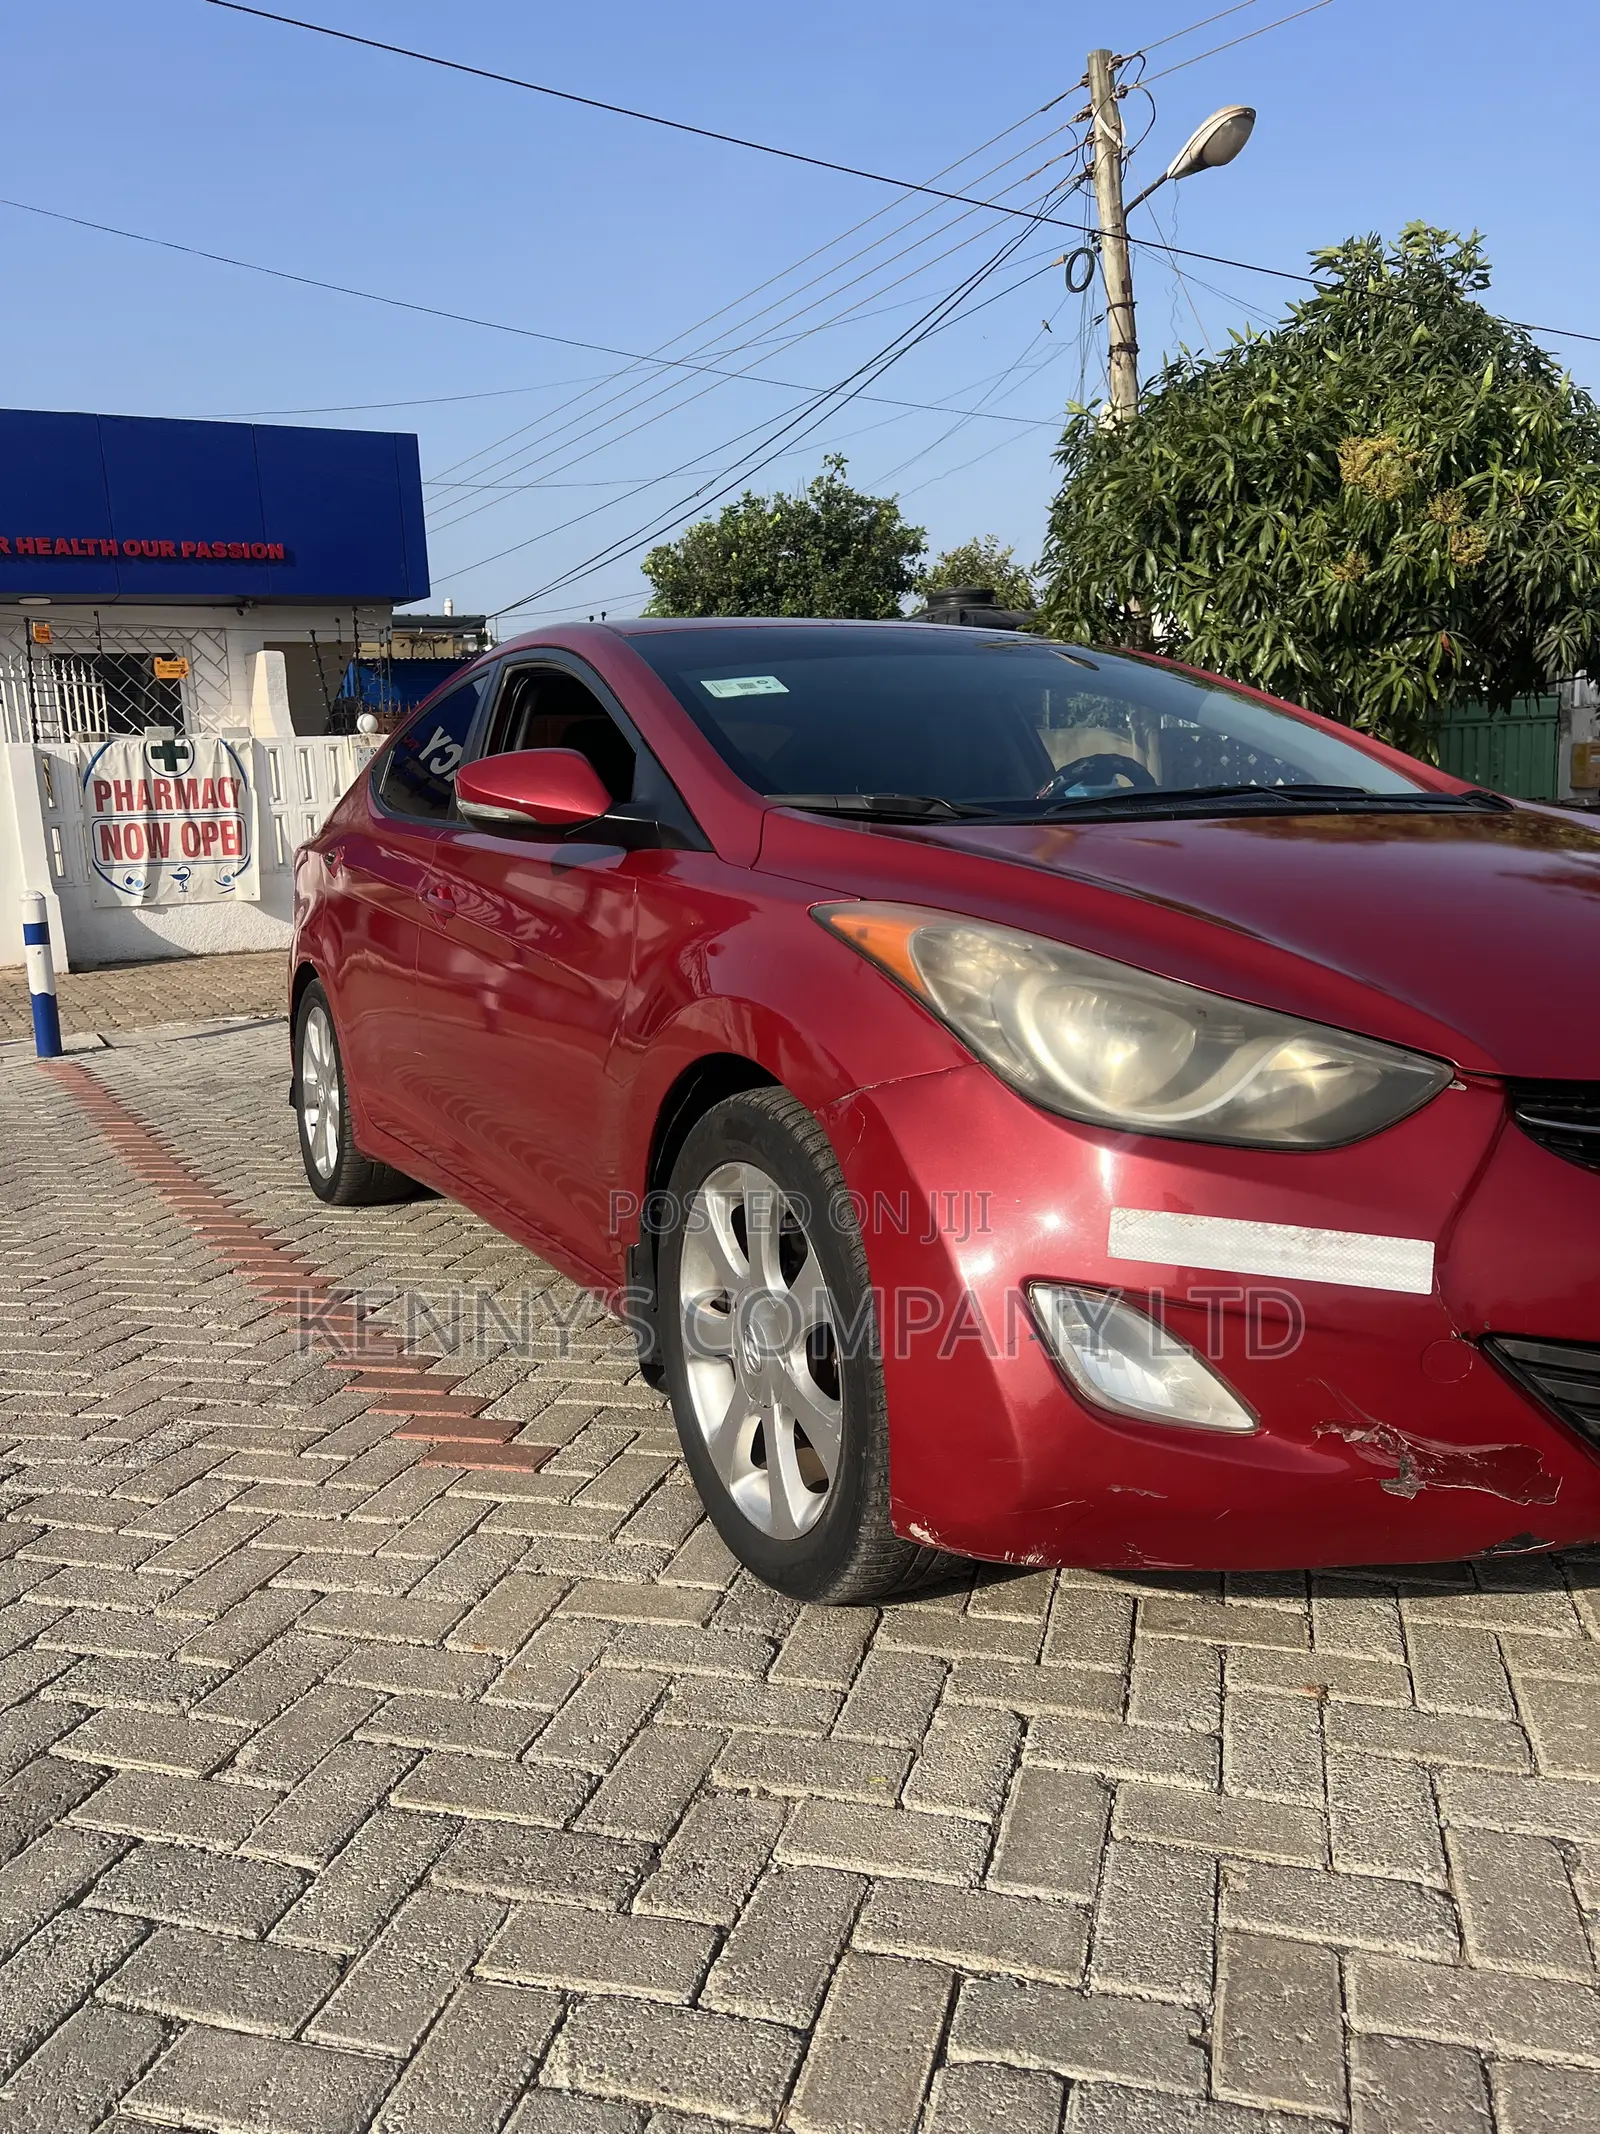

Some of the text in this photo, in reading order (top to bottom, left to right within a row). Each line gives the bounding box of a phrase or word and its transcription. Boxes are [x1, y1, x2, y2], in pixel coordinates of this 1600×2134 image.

[16, 537, 119, 556] HEALTH
[123, 539, 177, 557] OUR
[181, 541, 285, 559] PASSION
[93, 776, 241, 813] PHARMACY
[100, 822, 171, 861] NOW
